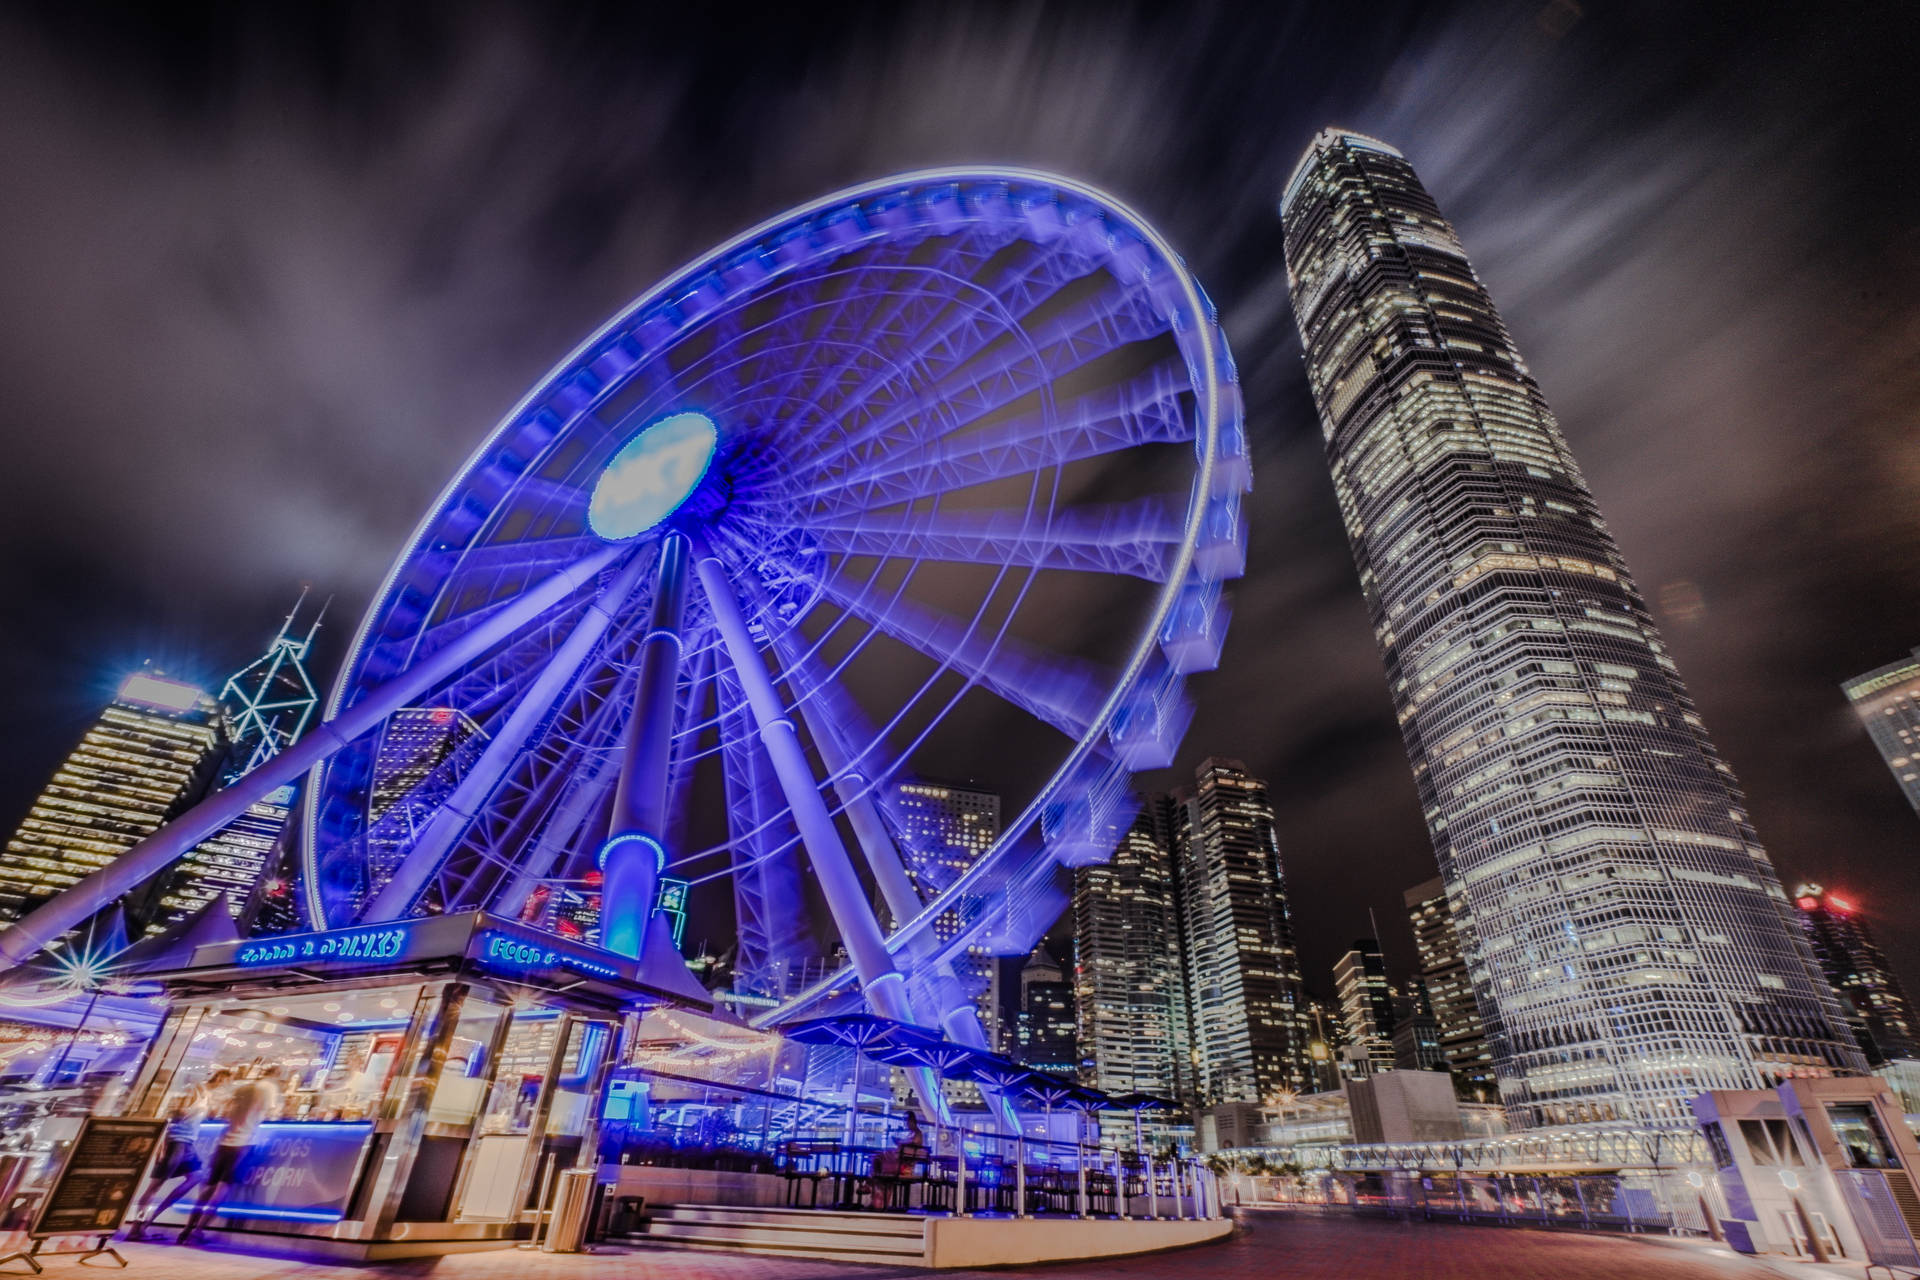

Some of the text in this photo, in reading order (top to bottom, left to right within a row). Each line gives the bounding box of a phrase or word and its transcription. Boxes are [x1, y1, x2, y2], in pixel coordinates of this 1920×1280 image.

[490, 938, 541, 964] FOOD
[270, 1137, 312, 1157] DOGS
[243, 1166, 306, 1187] OPCORN
